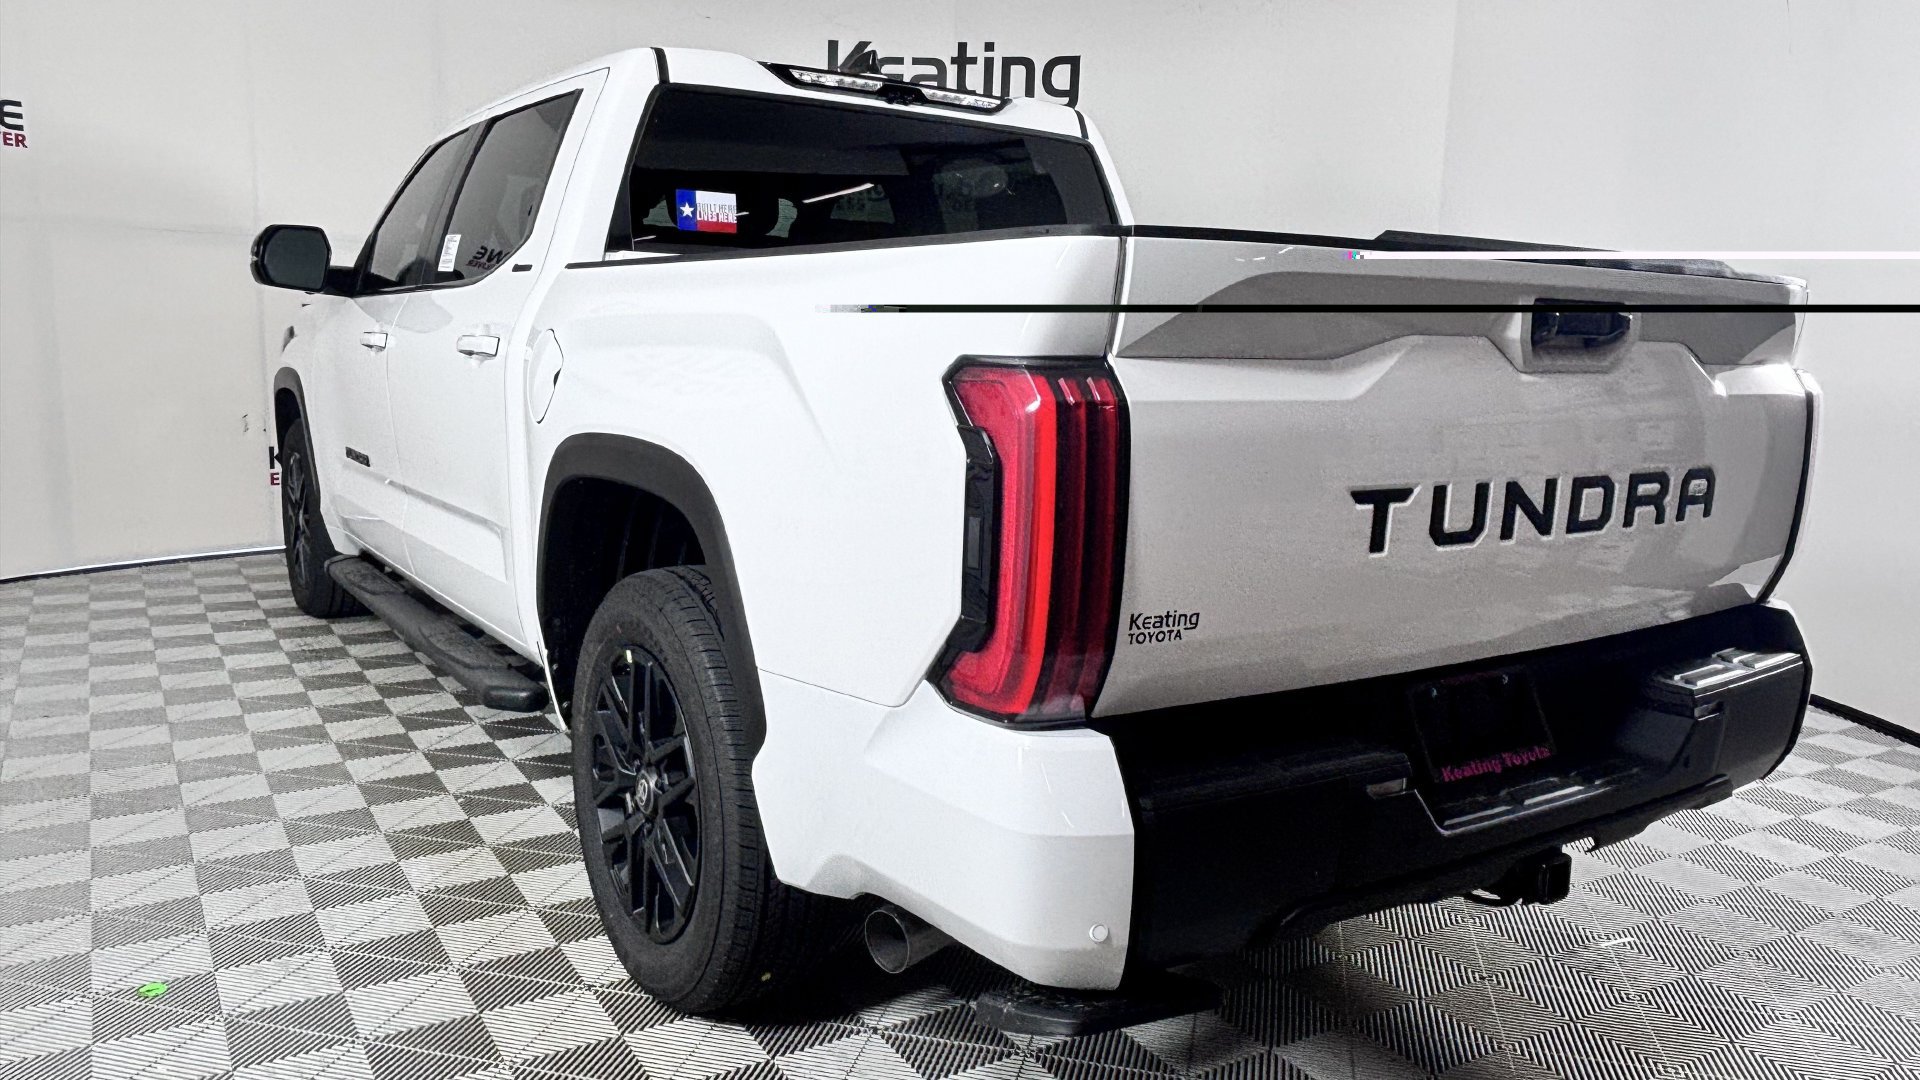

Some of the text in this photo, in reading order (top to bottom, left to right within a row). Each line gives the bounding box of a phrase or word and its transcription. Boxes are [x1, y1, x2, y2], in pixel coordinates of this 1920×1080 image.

[0, 131, 28, 148] ER
[696, 210, 738, 223] LIVES HERE
[1350, 467, 1716, 555] TUNDRA
[1129, 610, 1200, 631] Keating
[1128, 629, 1182, 645] TOYOTA
[1441, 745, 1551, 782] Keating Toyota
